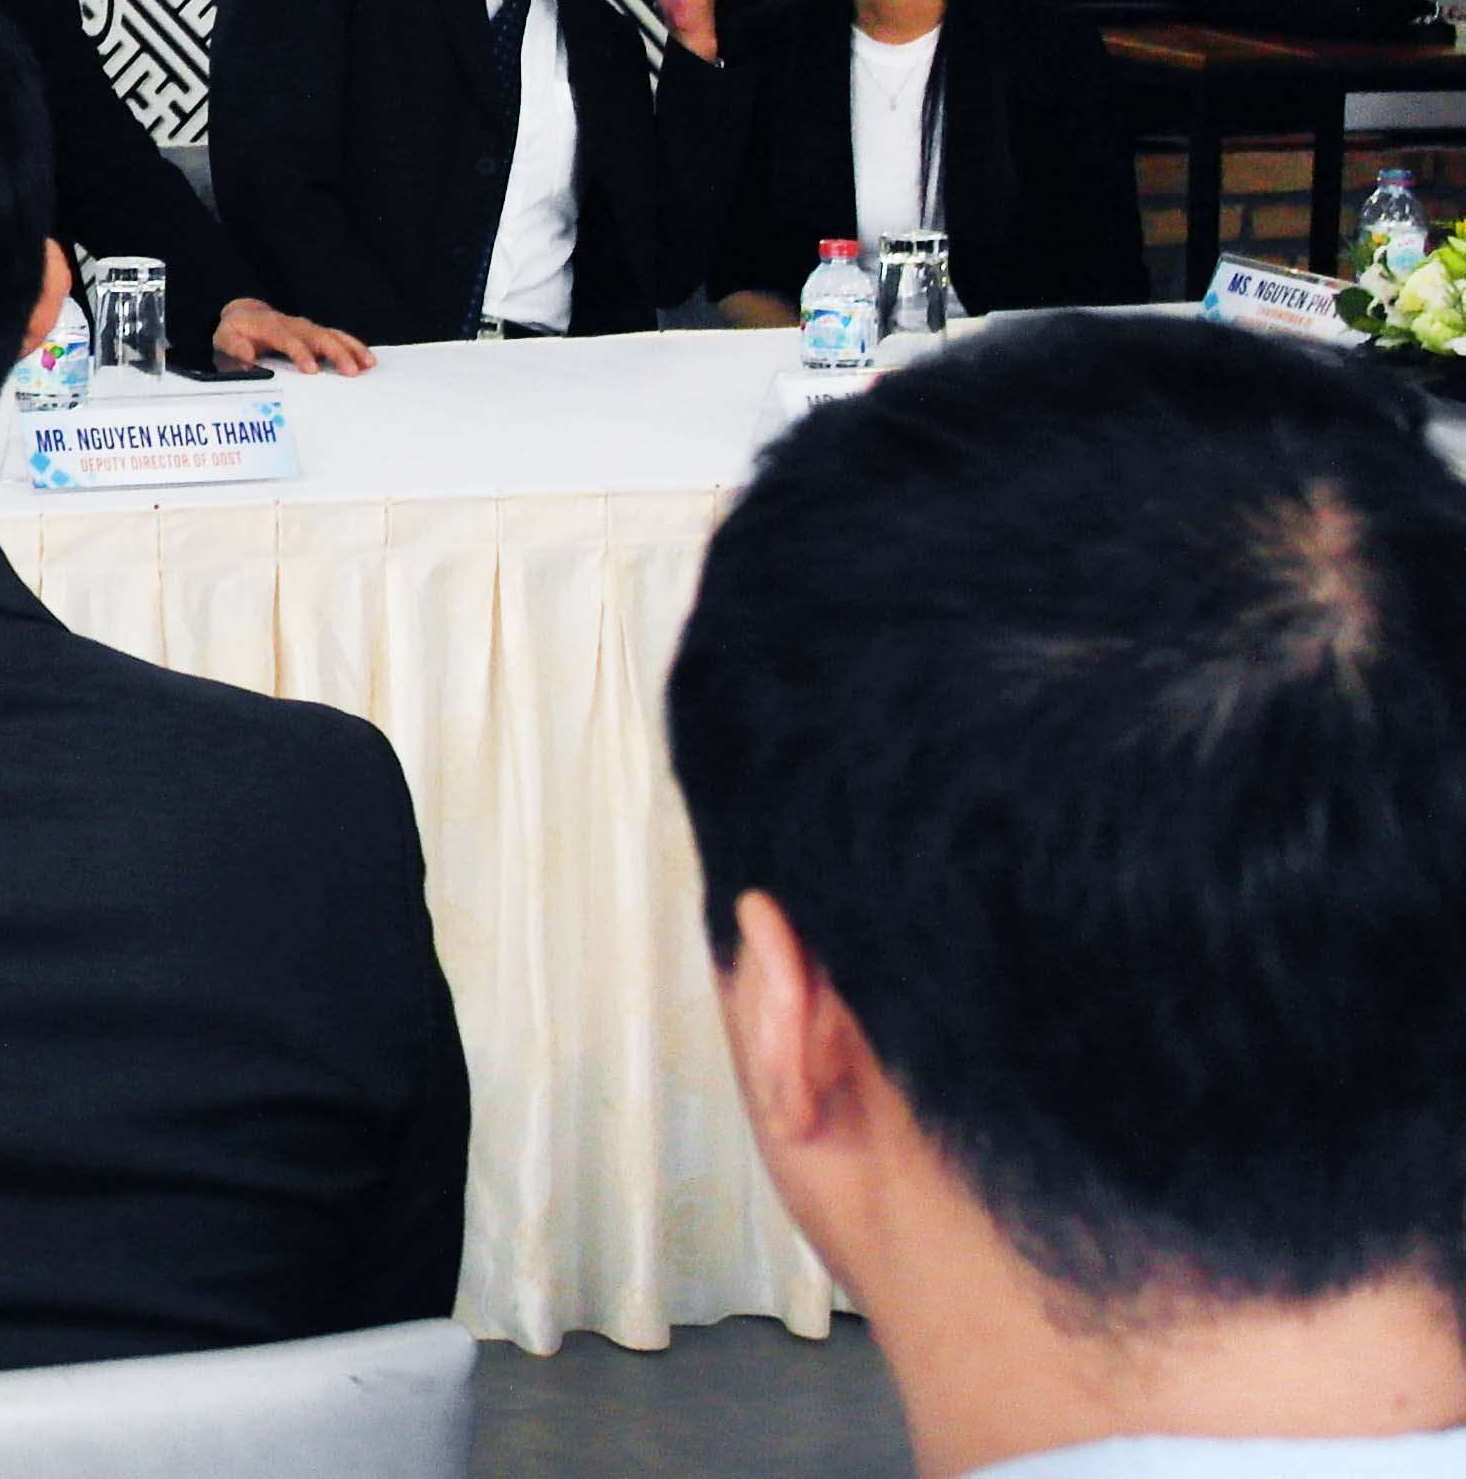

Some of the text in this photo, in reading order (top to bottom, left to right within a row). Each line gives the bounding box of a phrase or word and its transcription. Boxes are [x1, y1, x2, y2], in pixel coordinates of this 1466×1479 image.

[1254, 280, 1309, 309] NGUYEN
[36, 420, 277, 453] MR. NGUYEN KHAC THANH
[80, 455, 126, 473] DEPUTY
[131, 453, 189, 471] DIRECTOR
[194, 452, 207, 467] OF
